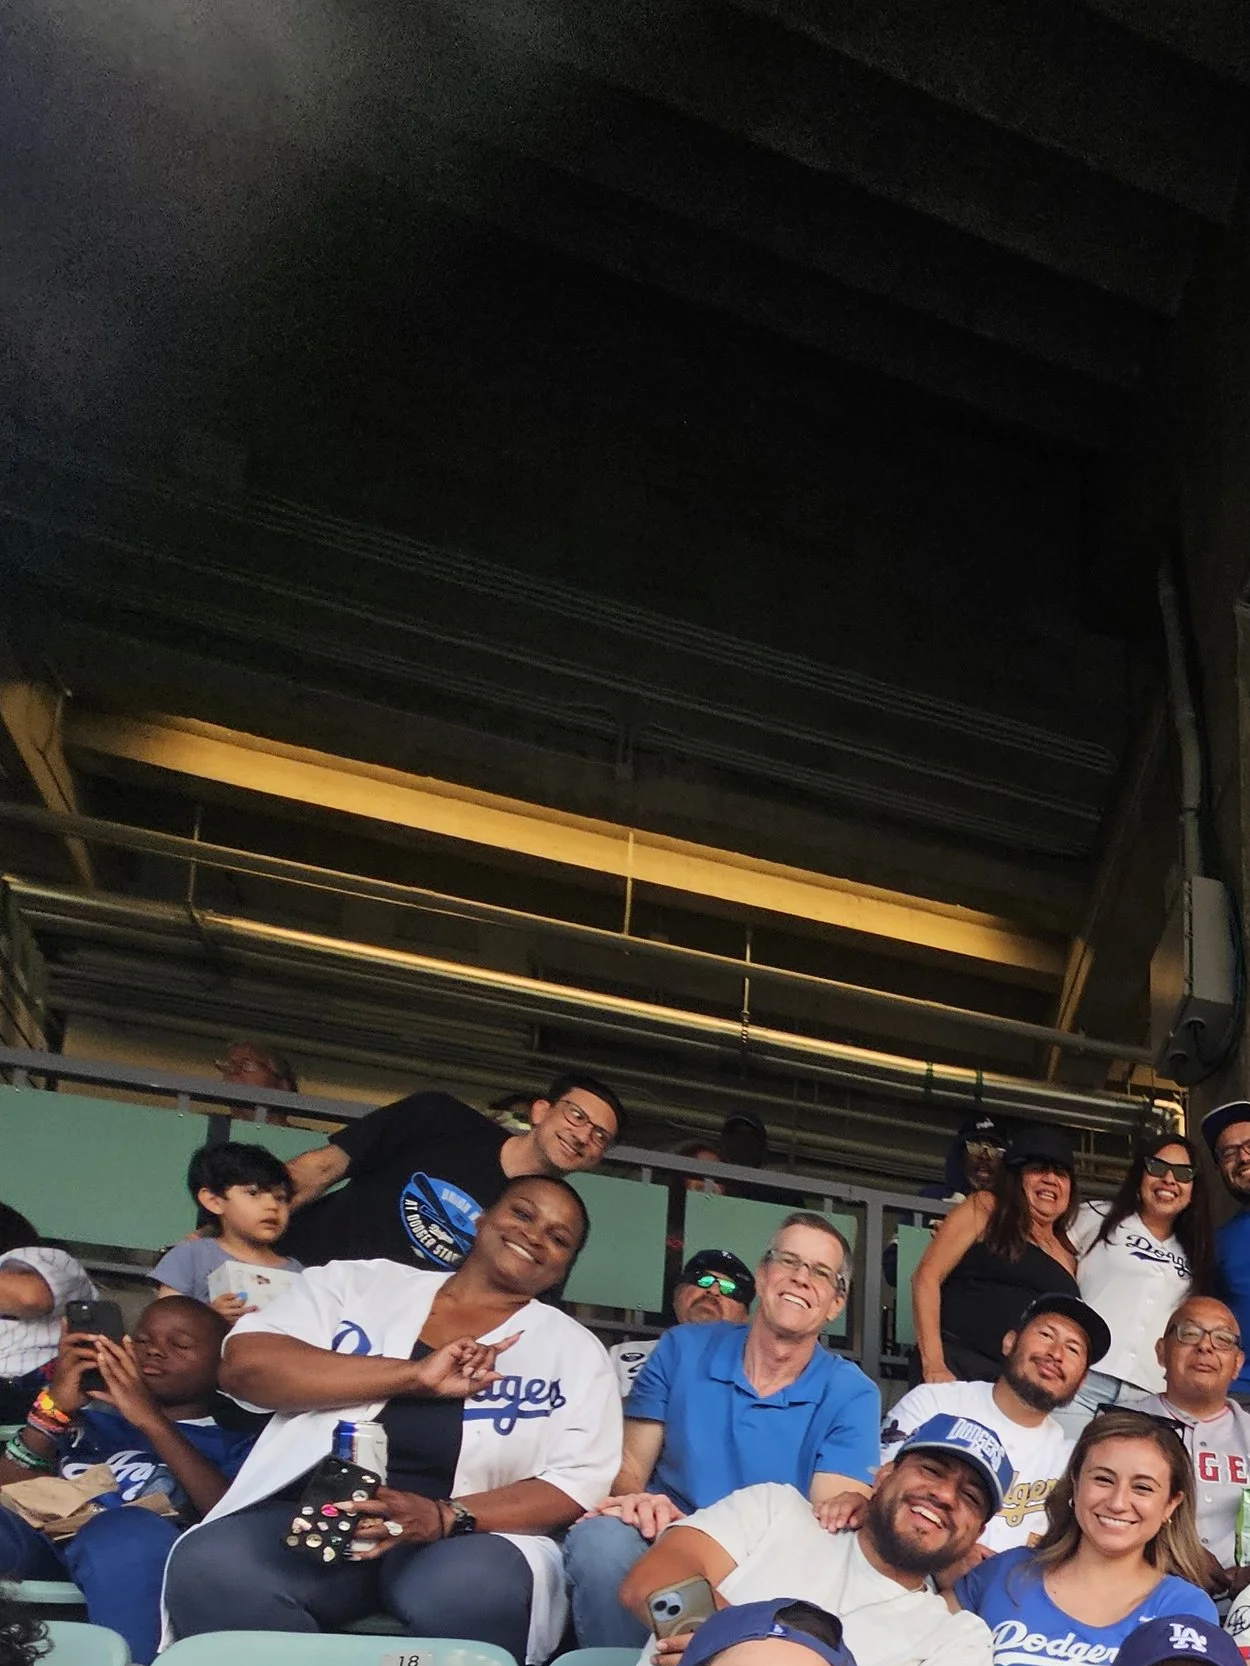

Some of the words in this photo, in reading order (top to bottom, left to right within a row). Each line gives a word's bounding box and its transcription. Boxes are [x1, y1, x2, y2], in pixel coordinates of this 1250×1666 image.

[406, 1213, 436, 1248] DODGER
[945, 1418, 1005, 1472] DODGERS
[1168, 1623, 1207, 1653] LA
